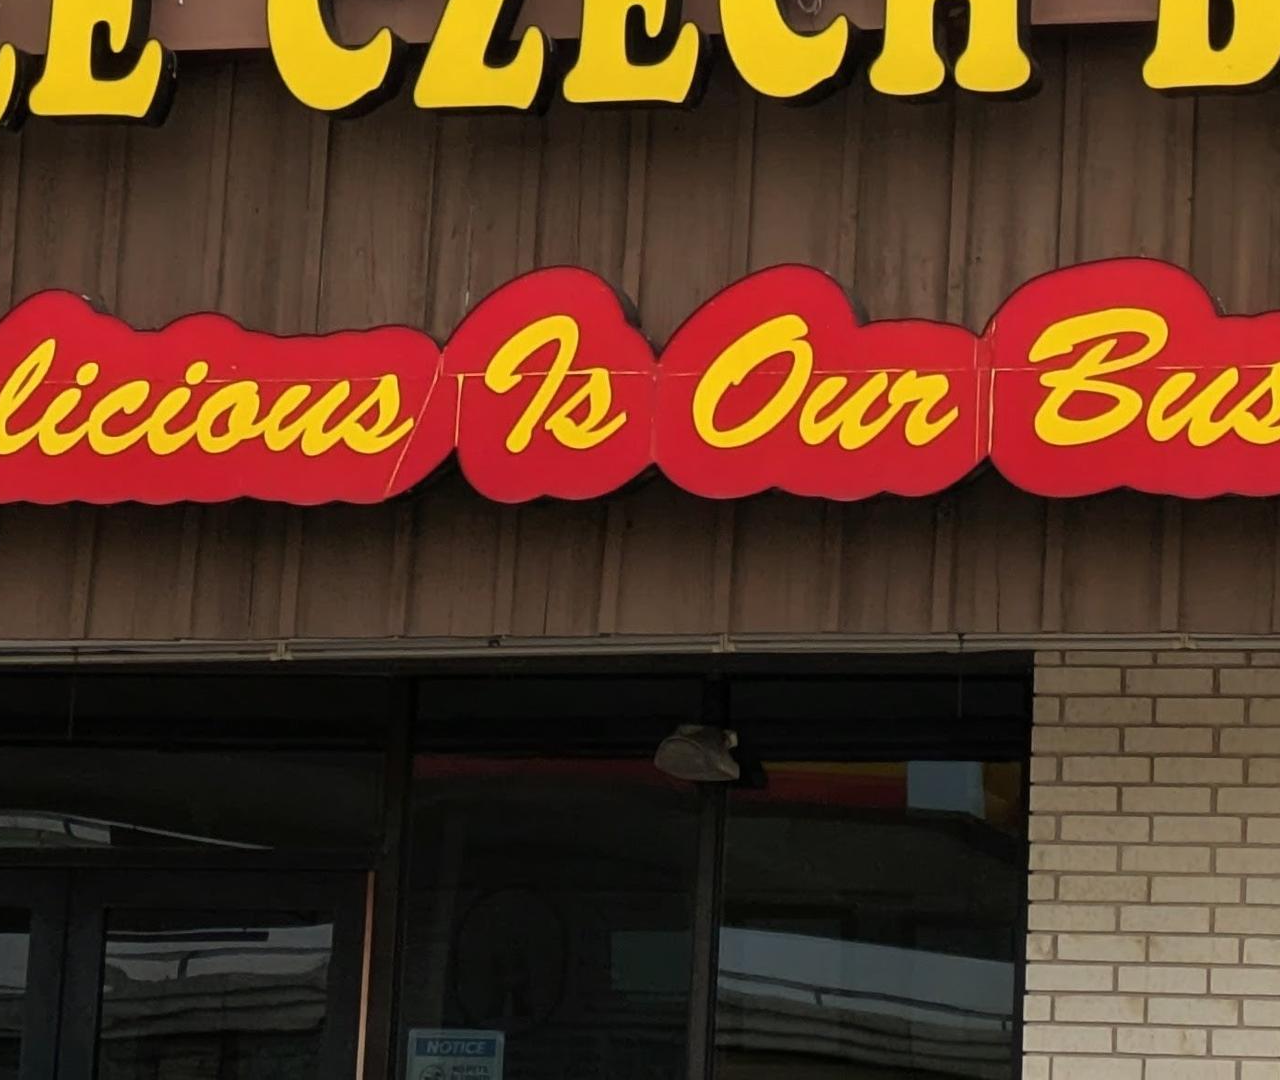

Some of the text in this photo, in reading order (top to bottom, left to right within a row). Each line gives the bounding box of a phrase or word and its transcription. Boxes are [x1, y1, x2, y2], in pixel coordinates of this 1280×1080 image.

[485, 314, 627, 452] Is
[692, 313, 958, 449] Our
[426, 1040, 487, 1054] NOTICE
